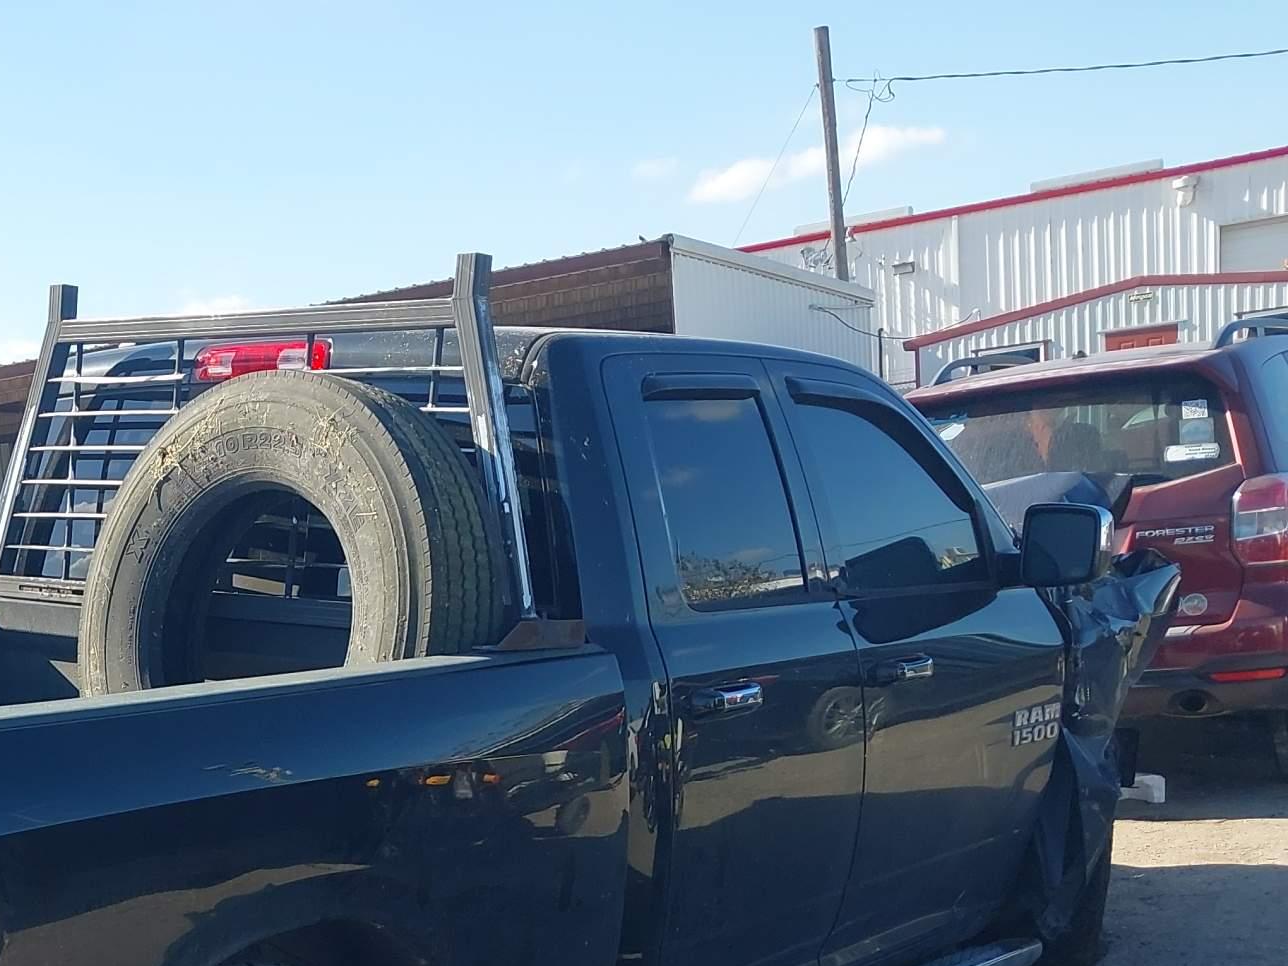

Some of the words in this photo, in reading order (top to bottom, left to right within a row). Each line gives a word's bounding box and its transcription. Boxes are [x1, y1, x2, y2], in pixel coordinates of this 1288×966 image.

[1135, 525, 1215, 540] FORESTER
[1015, 702, 1061, 727] RAM
[1013, 721, 1059, 747] 1500
